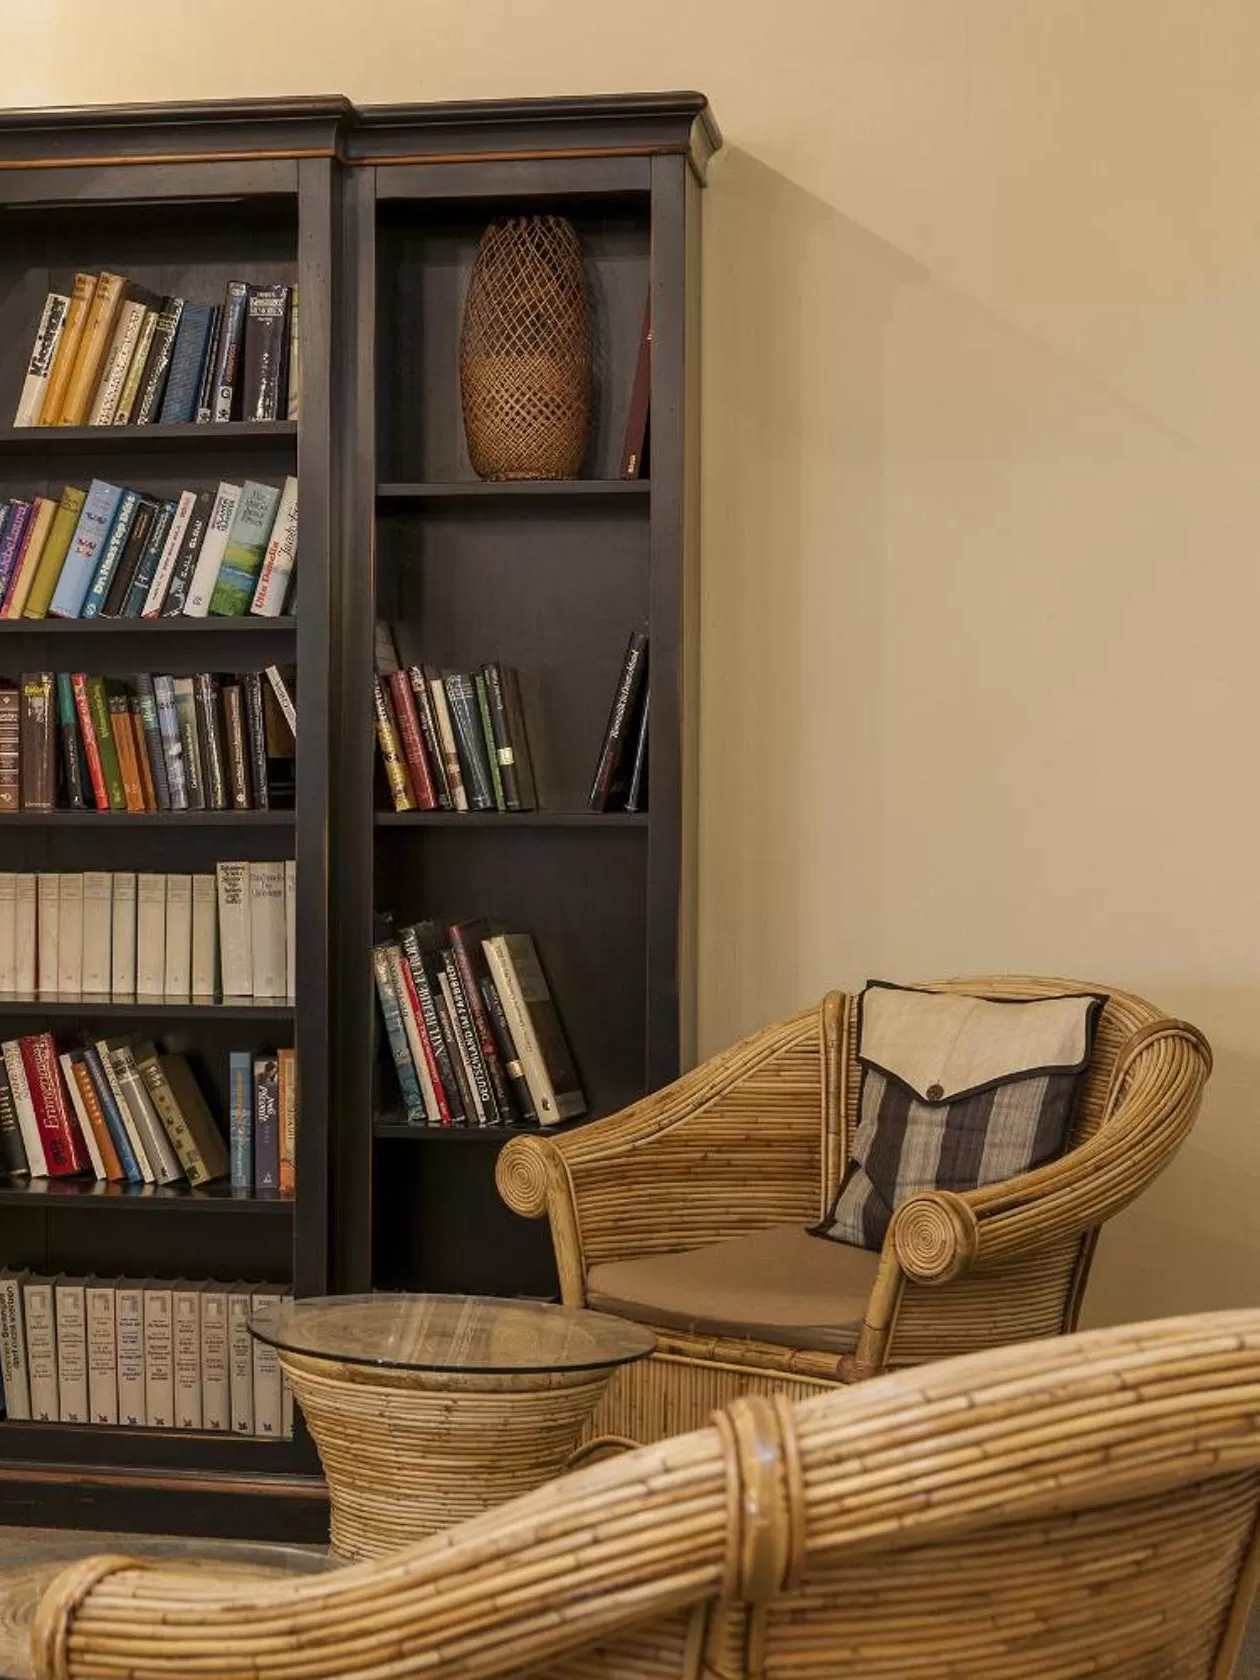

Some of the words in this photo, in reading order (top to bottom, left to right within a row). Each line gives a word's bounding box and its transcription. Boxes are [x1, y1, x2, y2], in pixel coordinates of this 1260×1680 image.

[446, 964, 466, 1014] FARBBILD
[459, 1014, 470, 1028] IM
[465, 1030, 490, 1102] DEUTSCHLAND
